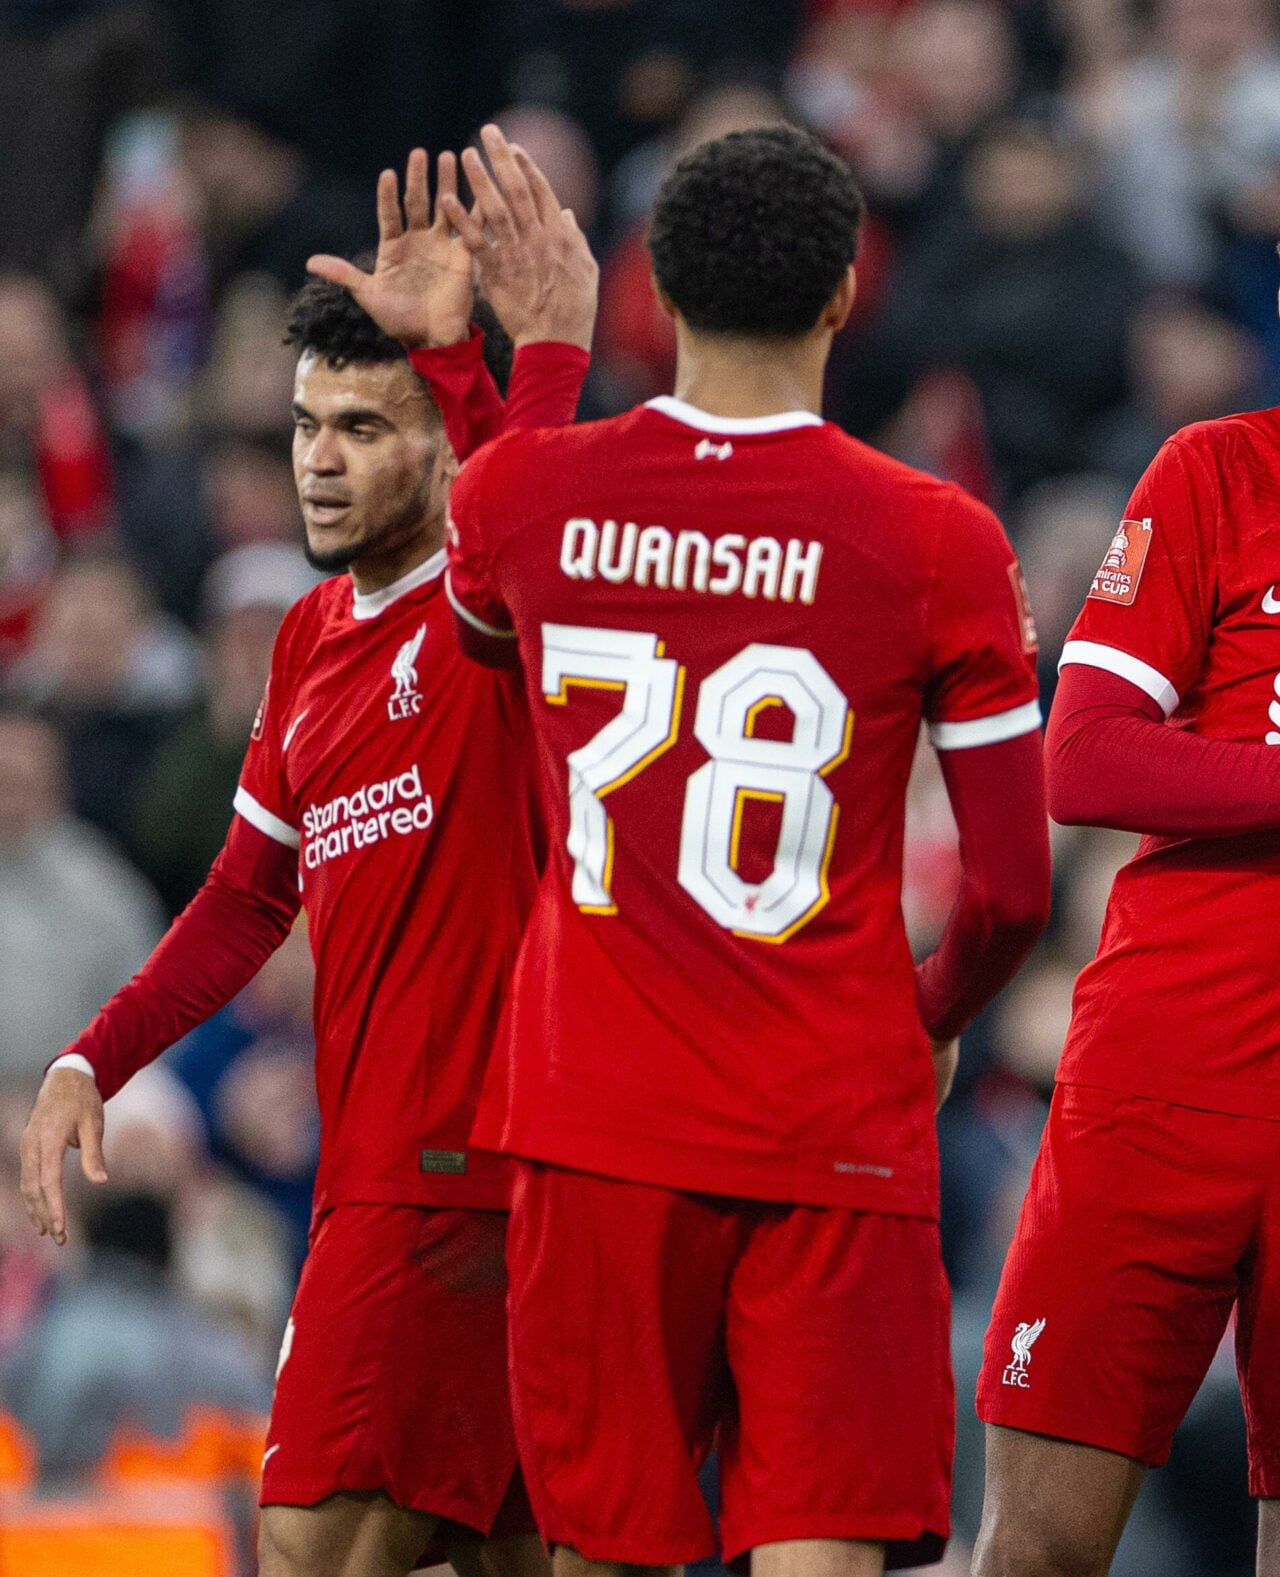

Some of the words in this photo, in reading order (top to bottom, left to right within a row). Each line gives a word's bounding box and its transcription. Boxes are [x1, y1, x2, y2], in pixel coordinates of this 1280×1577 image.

[560, 517, 823, 605] QUANSAH
[1101, 580, 1130, 596] CUP
[302, 763, 423, 839] standard
[541, 622, 856, 945] 78
[304, 794, 434, 869] chartered
[1002, 1369, 1031, 1389] L.F.C.
